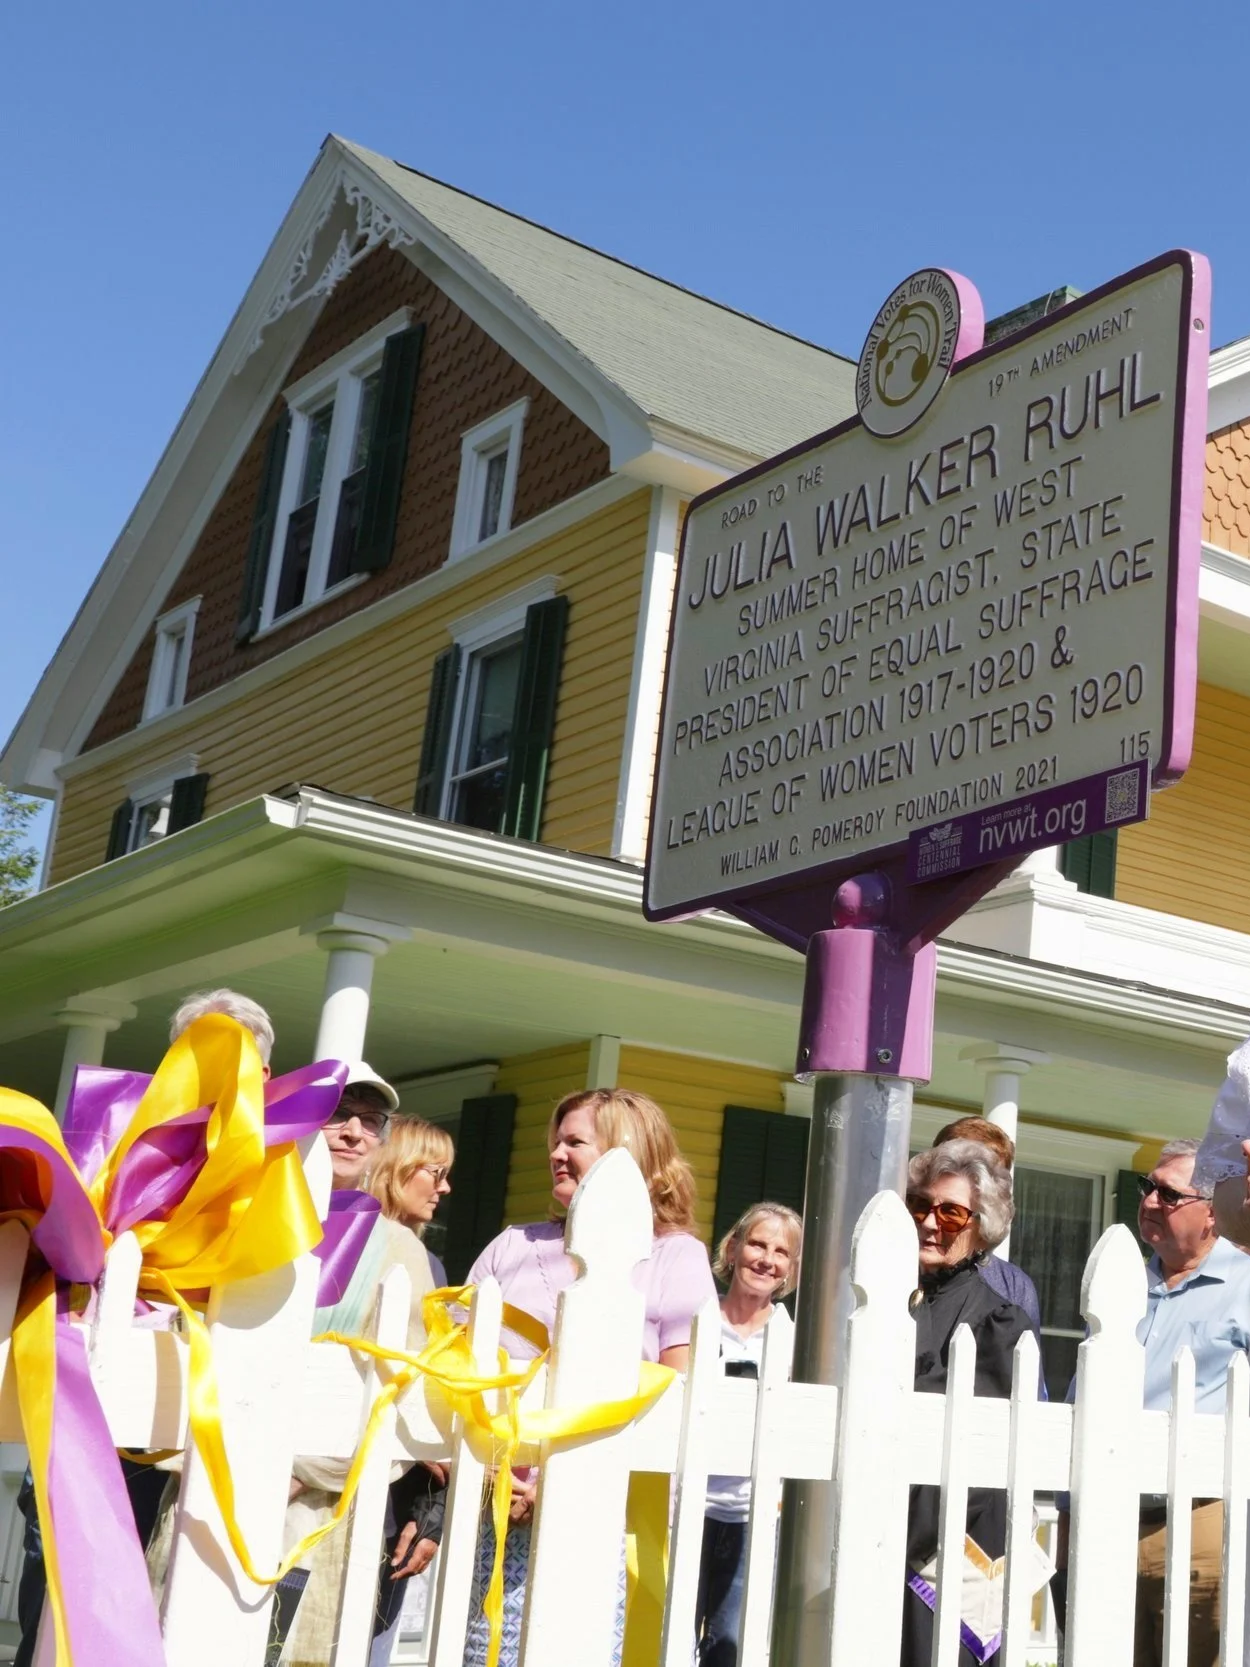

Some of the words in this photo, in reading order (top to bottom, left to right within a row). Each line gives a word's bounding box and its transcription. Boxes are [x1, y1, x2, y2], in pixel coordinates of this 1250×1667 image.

[875, 289, 907, 329] Votes
[908, 276, 926, 298] for
[926, 271, 955, 323] Women
[858, 333, 880, 412] National
[937, 320, 959, 370] Trail
[987, 364, 1023, 398] 19TH
[1029, 306, 1136, 378] AMENDMENT
[687, 519, 796, 611] JULIA
[815, 422, 1000, 557] WALKER
[1023, 350, 1164, 463] RUHL
[720, 497, 759, 530] ROAD
[766, 483, 788, 508] TO
[796, 464, 824, 494] THE
[737, 565, 841, 637] SUMMER
[851, 526, 928, 591] HOME
[939, 503, 979, 551] OF
[993, 454, 1085, 528] WEST
[703, 629, 805, 698] VIRGINIA
[815, 546, 1000, 652] SUFFRAGIST,
[1020, 493, 1125, 570] STATE
[673, 672, 811, 756] PRESIDENT
[820, 653, 859, 699] OF
[868, 616, 964, 683] EQUAL
[977, 537, 1157, 641] SUFFRAGE
[717, 694, 885, 789] ASSOCIATION
[897, 640, 1037, 725] 1917-1920
[1050, 623, 1076, 670] &
[666, 789, 763, 851] LEAGUE
[771, 773, 808, 817] OF
[819, 736, 915, 803] WOMEN
[929, 692, 1056, 769] VOTERS
[1069, 663, 1145, 725] 1920
[1119, 729, 1152, 764] 115
[720, 838, 780, 878] WILLIAM
[788, 834, 804, 857] C.
[811, 807, 886, 852] POMEROY
[894, 771, 1003, 828] FOUNDATION
[1014, 754, 1060, 794] 2021
[978, 797, 1088, 854] nvwt.org
[980, 811, 1002, 827] Learn
[1002, 806, 1023, 820] more
[1023, 802, 1032, 815] at
[916, 856, 961, 878] COMMISSION
[917, 845, 961, 868] CENTENNIAL
